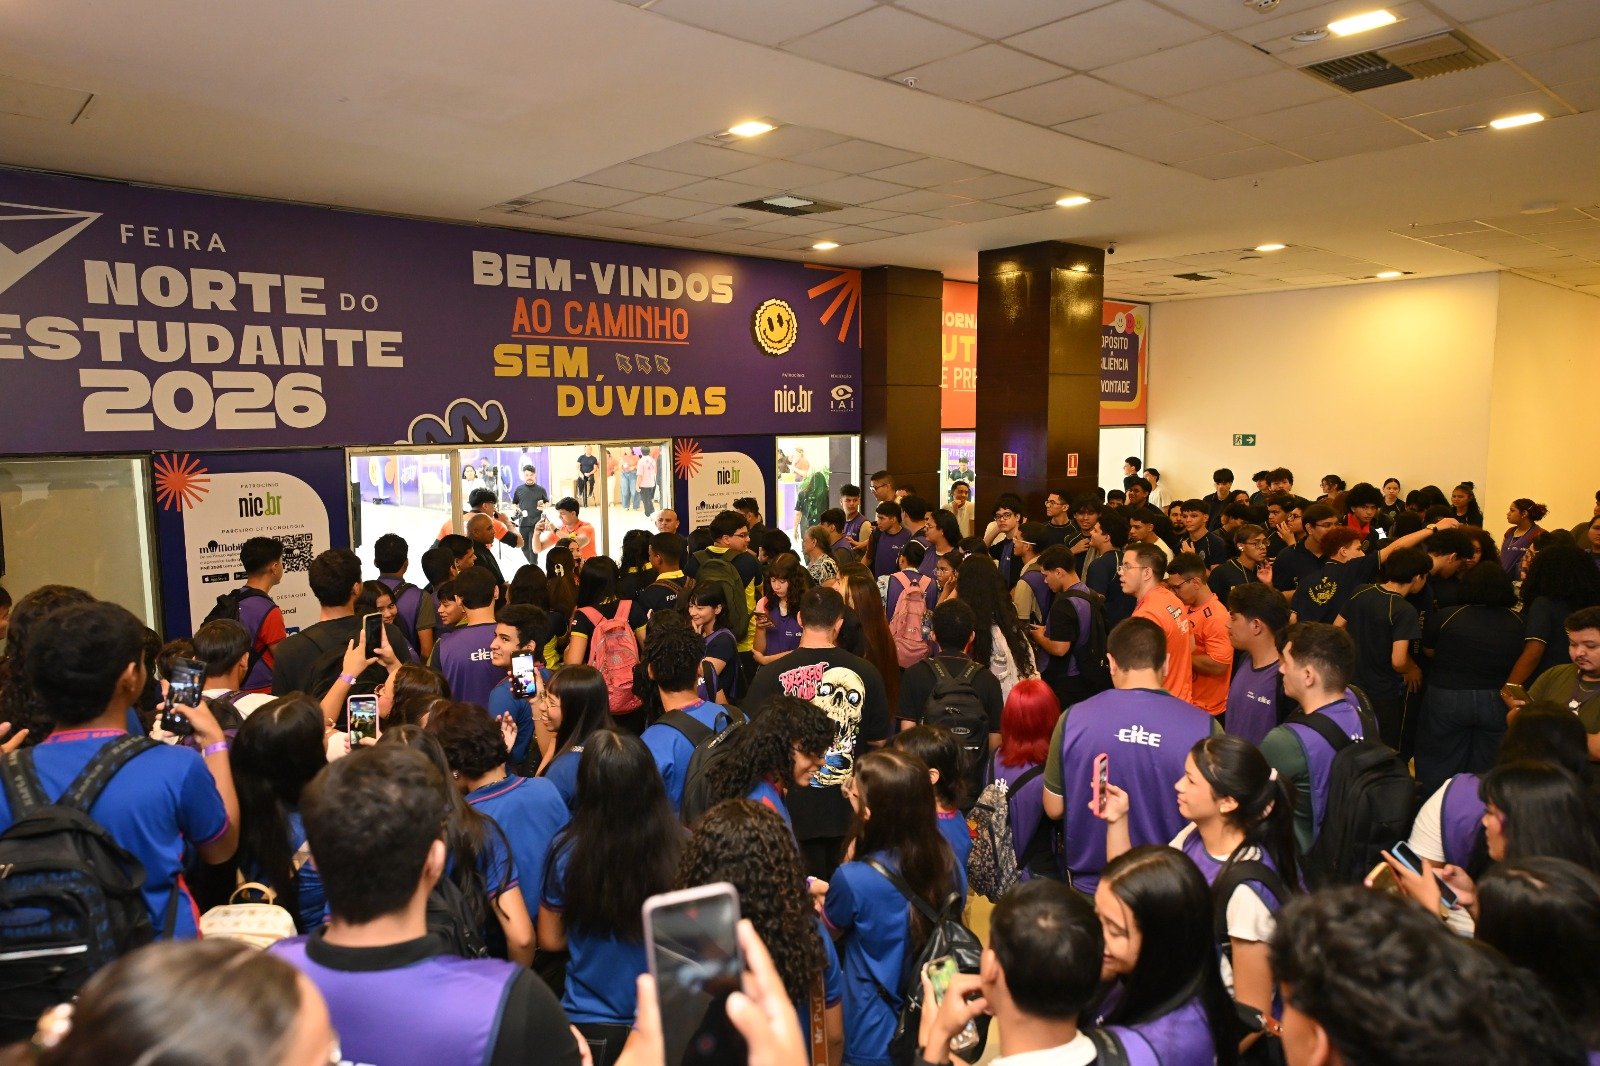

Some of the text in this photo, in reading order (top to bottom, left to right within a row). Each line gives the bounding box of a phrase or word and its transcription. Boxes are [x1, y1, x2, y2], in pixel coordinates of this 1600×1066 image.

[120, 224, 227, 253] FEIRA
[84, 260, 379, 316] NORTE DO
[472, 250, 734, 304] BEM-VINDOS
[512, 297, 690, 341] AO CAMINHO
[0, 313, 404, 368] ESTUDANTE
[494, 344, 589, 379] SEM
[79, 368, 327, 432] 2026
[557, 374, 727, 417] DÚVIDAS
[774, 384, 813, 413] nic.br
[1100, 379, 1131, 394] VONTADE
[717, 466, 741, 486] nic.br
[238, 491, 282, 518] nic.br
[266, 523, 305, 532] TECNOLOGIA
[277, 592, 306, 600] DESTAQUE
